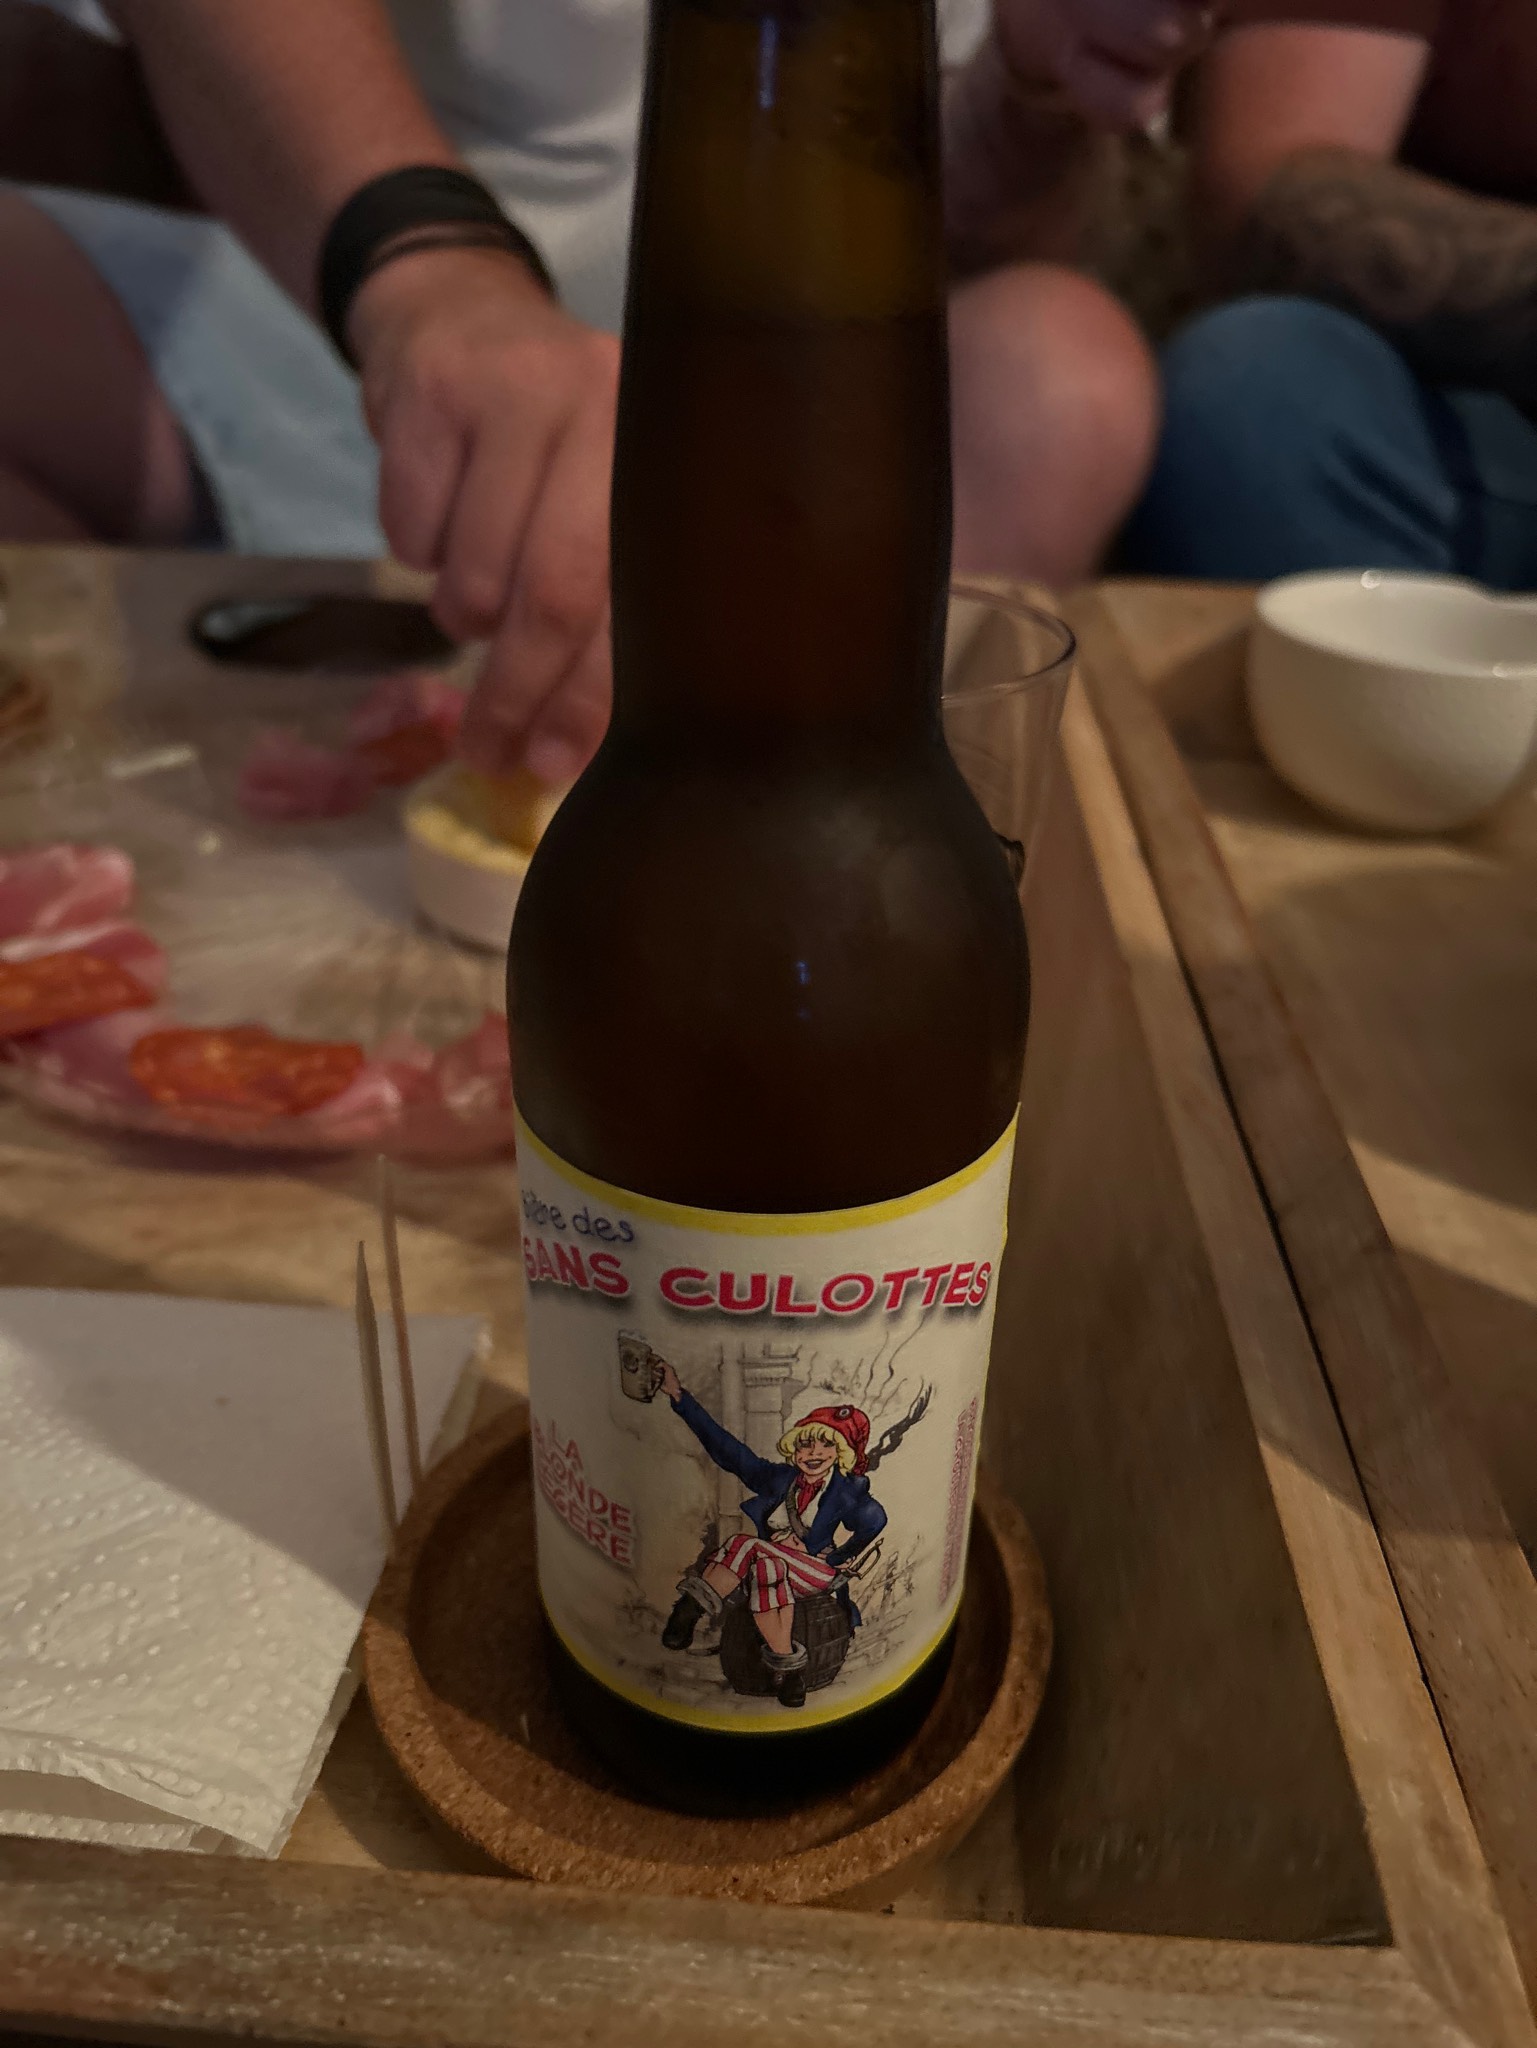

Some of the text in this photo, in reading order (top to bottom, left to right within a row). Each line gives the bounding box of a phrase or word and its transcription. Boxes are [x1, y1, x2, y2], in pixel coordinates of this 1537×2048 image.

[572, 1206, 634, 1243] des
[523, 1236, 993, 1316] SANS CULOTTES
[533, 1420, 632, 1534] ONDE
